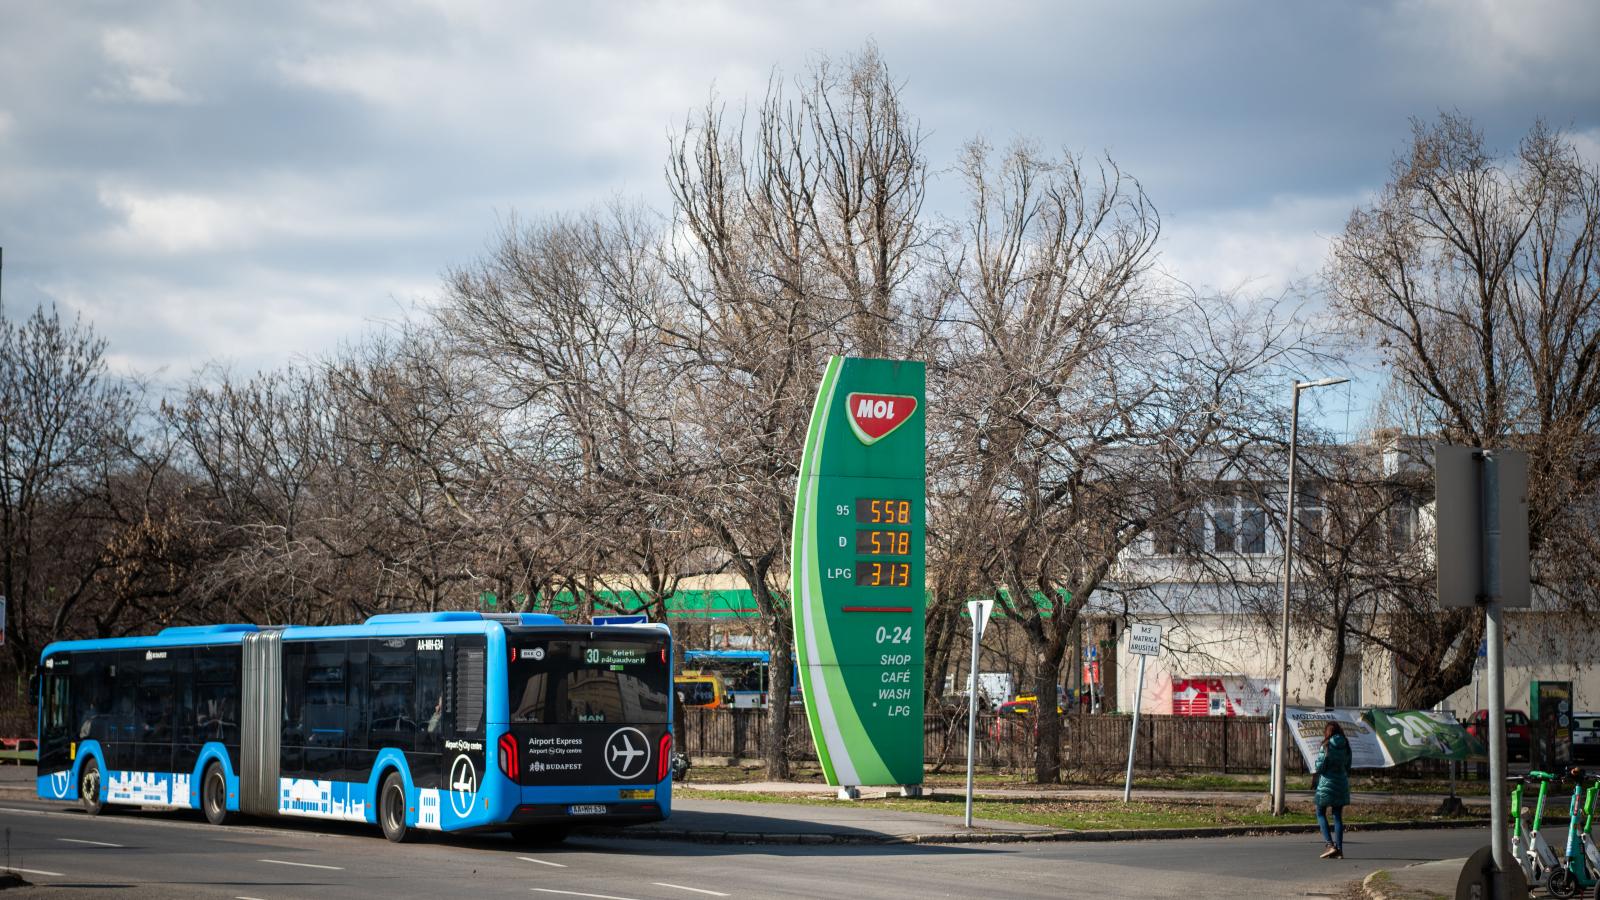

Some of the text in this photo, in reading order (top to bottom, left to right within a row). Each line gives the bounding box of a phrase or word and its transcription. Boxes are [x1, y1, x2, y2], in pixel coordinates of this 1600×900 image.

[857, 399, 895, 420] MOL
[836, 500, 909, 524] 95 558
[839, 531, 909, 554] D 578
[828, 563, 909, 586] LPG 313
[876, 626, 912, 644] 0-24
[1133, 635, 1157, 643] MATRICA
[587, 648, 599, 663] 30
[880, 654, 912, 666] SHOP
[882, 669, 910, 682] CAFÉ
[878, 689, 911, 700] WASH
[888, 706, 910, 716] LPG
[529, 738, 582, 746] Airport Express
